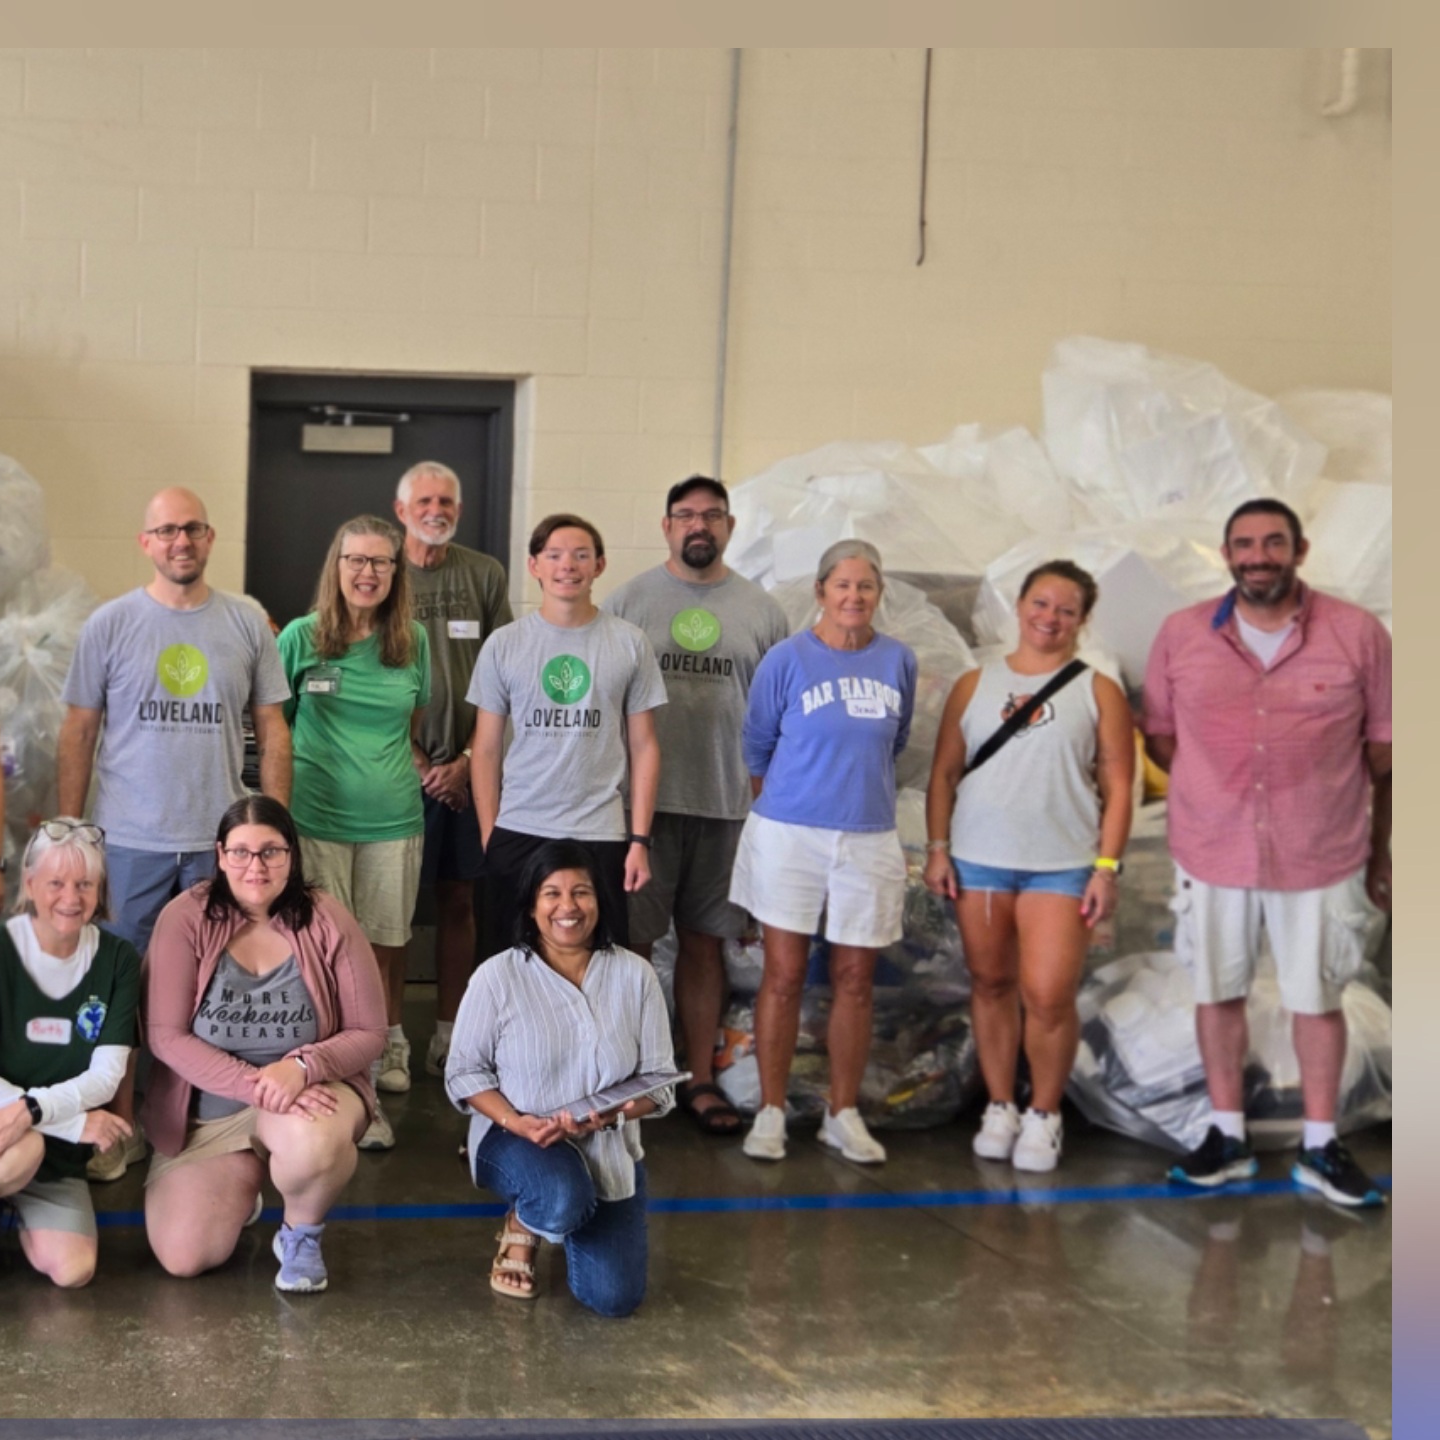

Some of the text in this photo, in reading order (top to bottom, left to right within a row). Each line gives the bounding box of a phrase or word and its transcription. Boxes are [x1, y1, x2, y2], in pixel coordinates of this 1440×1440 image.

[661, 653, 733, 677] OVELAND
[802, 681, 835, 717] BAR
[139, 700, 223, 724] LOVELAND
[525, 708, 601, 728] LOVELAND
[221, 988, 291, 1005] MORE
[198, 1001, 313, 1025] Weekends
[210, 1026, 301, 1039] PLEASE
